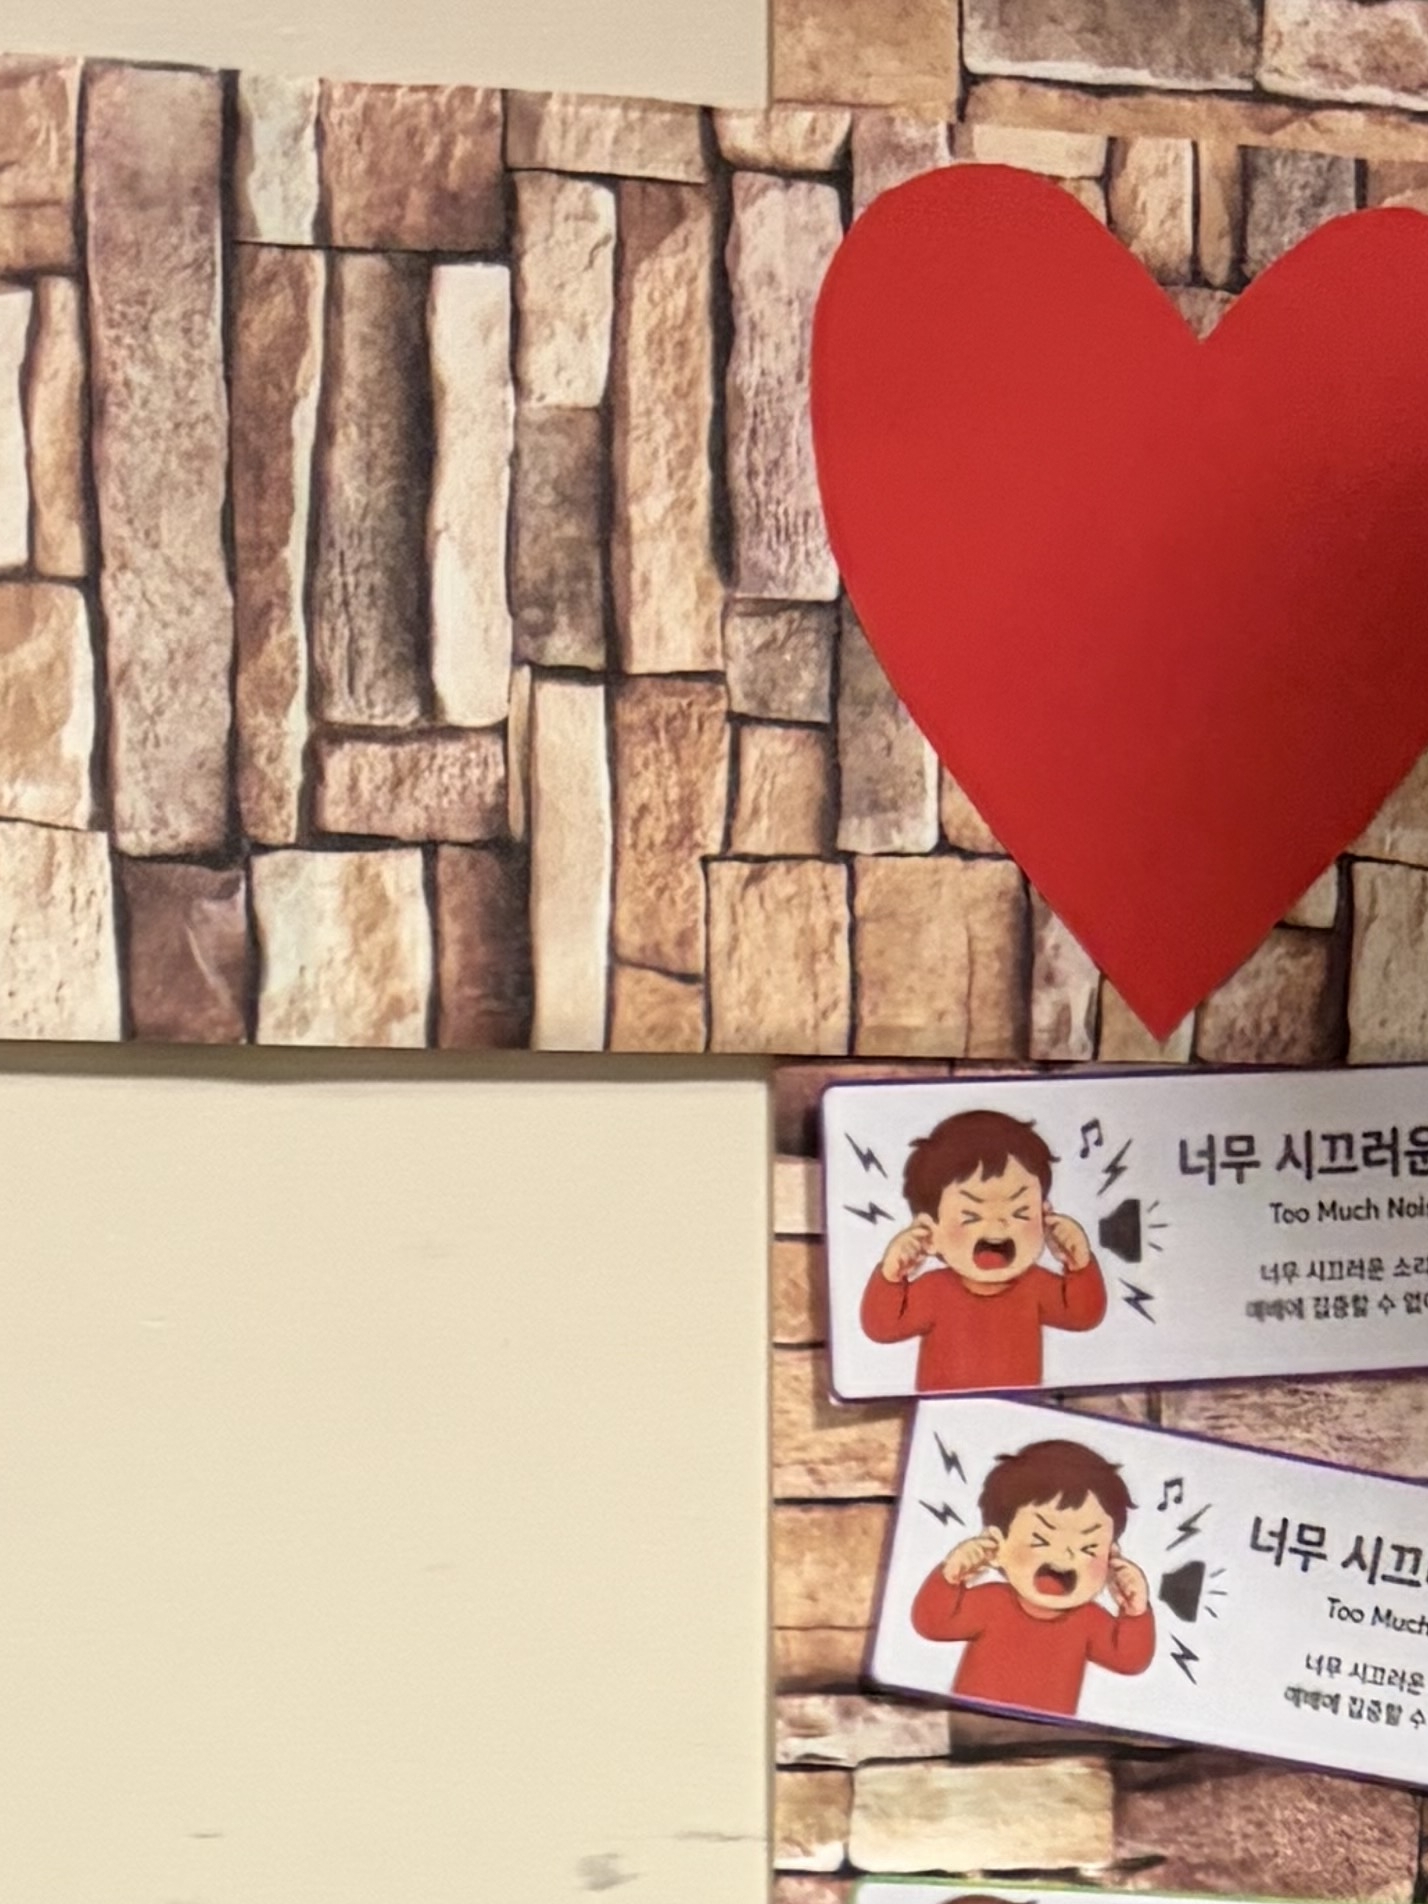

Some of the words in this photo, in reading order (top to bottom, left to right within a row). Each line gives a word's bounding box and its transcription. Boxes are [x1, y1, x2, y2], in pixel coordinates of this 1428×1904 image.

[1179, 1134, 1260, 1185] 너무
[1270, 1202, 1309, 1224] Too
[1318, 1198, 1379, 1222] Much
[1260, 1262, 1299, 1284] 너무
[1307, 1258, 1384, 1281] 시끄러운
[1378, 1294, 1396, 1315] 수
[1250, 1516, 1327, 1572] 너무
[1327, 1597, 1365, 1624] Too
[1306, 1653, 1341, 1677] 너무
[1349, 1663, 1425, 1696] 시끄러운
[1410, 1709, 1427, 1728] 수
